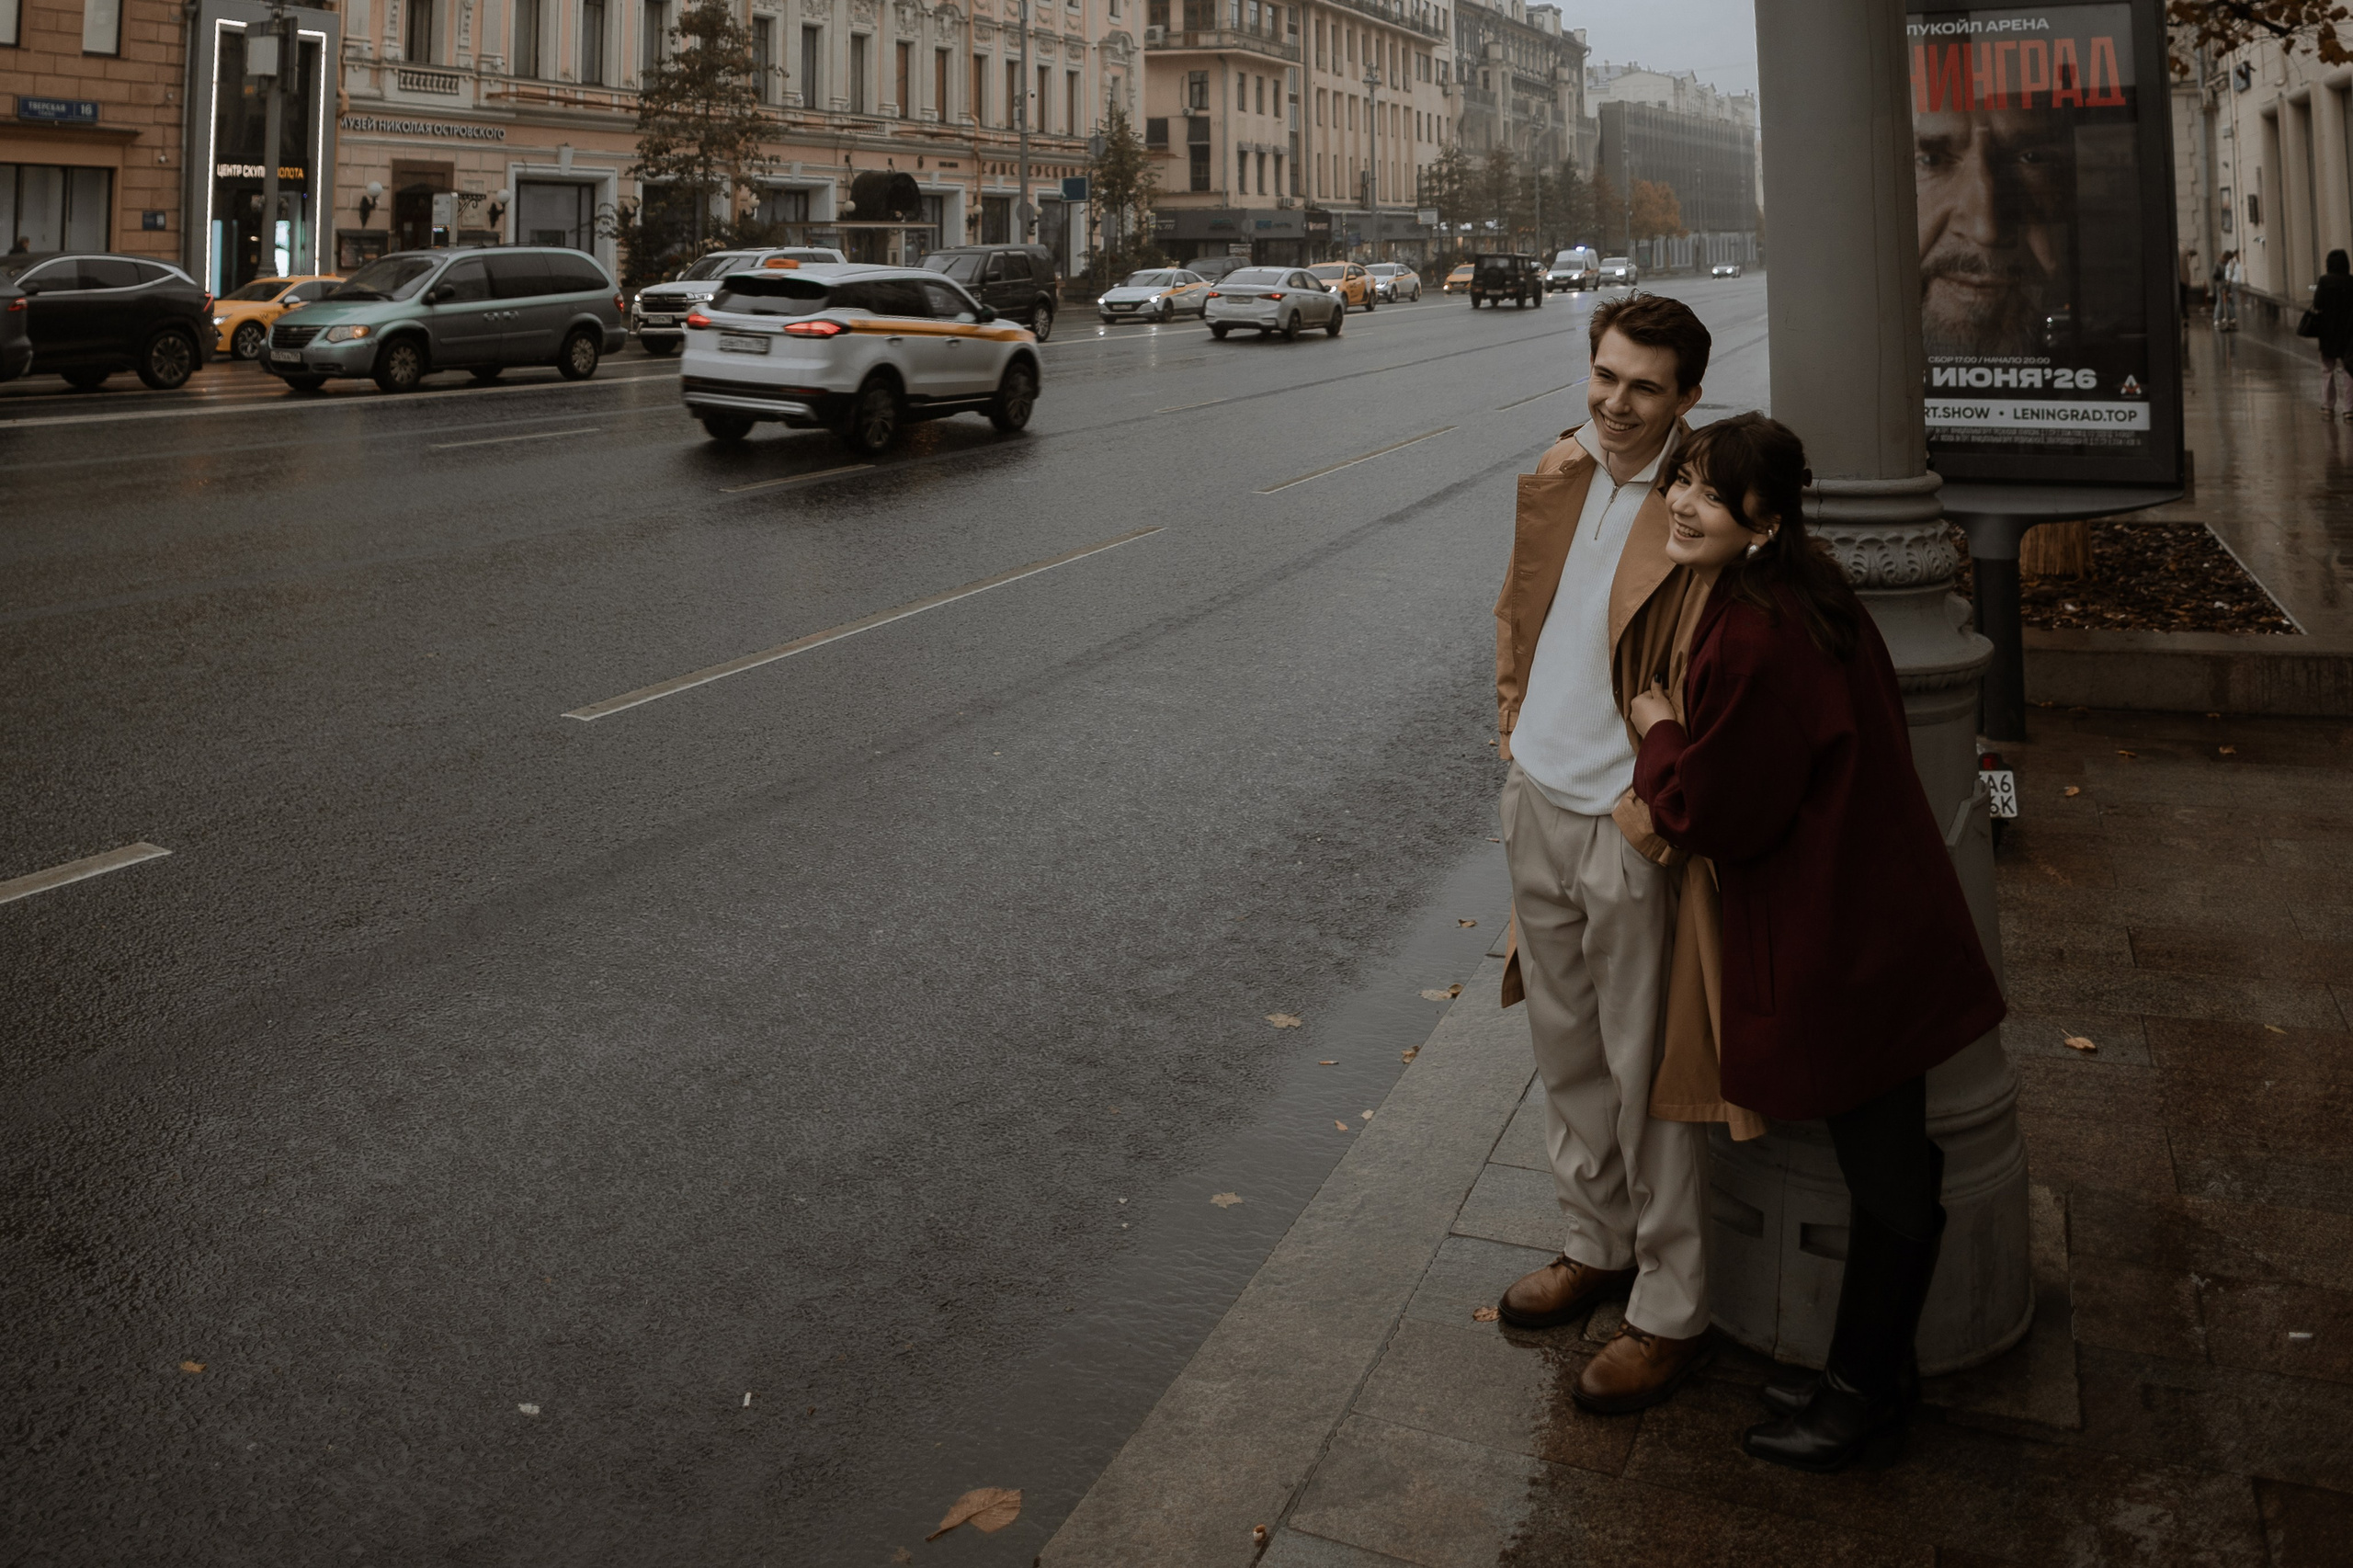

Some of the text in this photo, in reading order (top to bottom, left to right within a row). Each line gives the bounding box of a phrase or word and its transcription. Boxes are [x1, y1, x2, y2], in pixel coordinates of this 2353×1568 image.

[1985, 17, 2050, 32] АРЕНА
[1910, 36, 2127, 113] НИНГРАД
[28, 100, 93, 116] ТВЕРСКАЯ 16
[379, 119, 432, 134] НИКОЛАЯ
[434, 123, 506, 140] ОСТРОВСКОГО
[217, 164, 305, 180] ЦЕНТР СКУП ОЛОТА
[1955, 356, 1977, 364] 17:00
[1984, 357, 2022, 365] НАЧАЛО
[2023, 357, 2051, 365] 20:00
[1924, 406, 2138, 423] RT.SHOW LENINGRAD.TOP
[1979, 774, 2011, 793] A6
[1989, 796, 2015, 814] 6K
